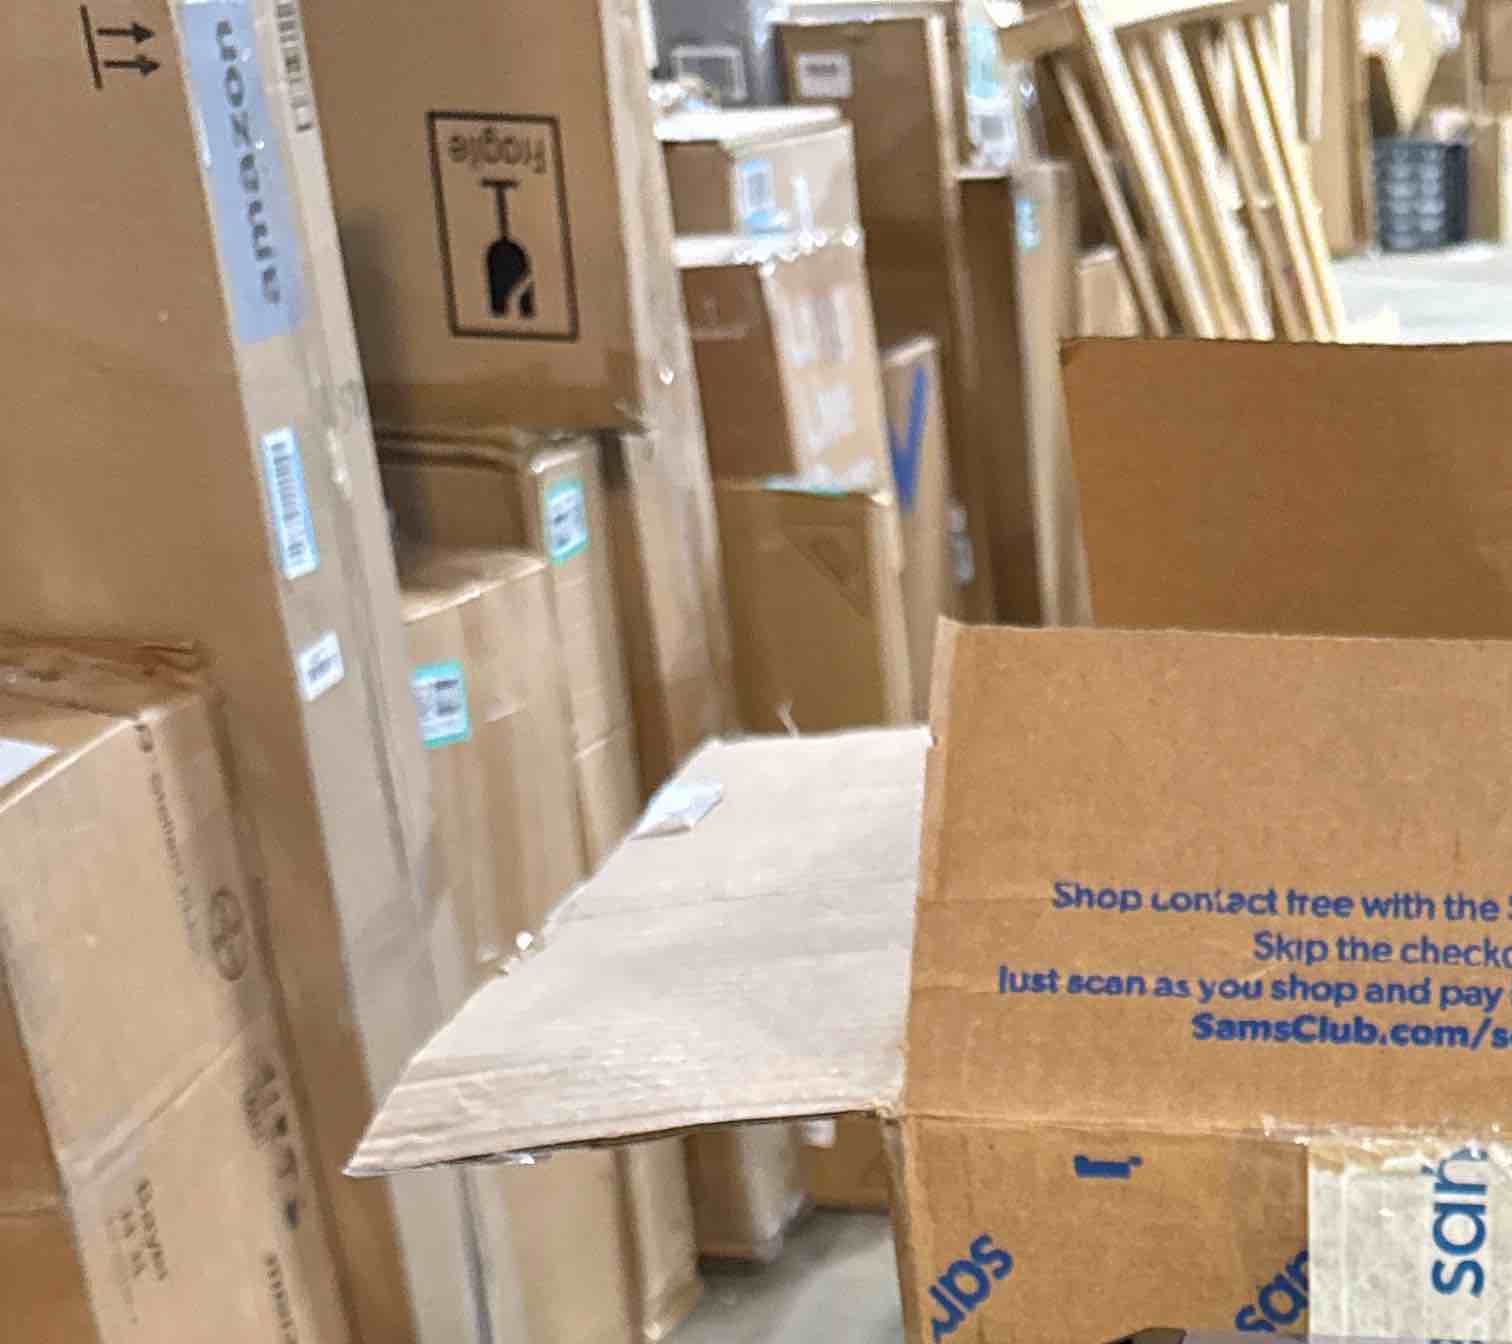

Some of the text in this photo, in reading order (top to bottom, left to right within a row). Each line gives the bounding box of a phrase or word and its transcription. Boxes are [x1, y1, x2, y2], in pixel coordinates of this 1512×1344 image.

[449, 128, 549, 175] Fragile
[1053, 881, 1142, 914] Shop
[1287, 889, 1354, 918] free
[1361, 891, 1435, 920] with
[1445, 892, 1499, 922] the
[1253, 930, 1329, 966] Skip
[1336, 934, 1392, 964] the
[1066, 969, 1146, 997] scan
[1153, 975, 1190, 998] as
[1197, 976, 1263, 1005] you
[1270, 973, 1359, 1007] shop
[1364, 976, 1431, 1005] and
[1440, 982, 1502, 1013] pay
